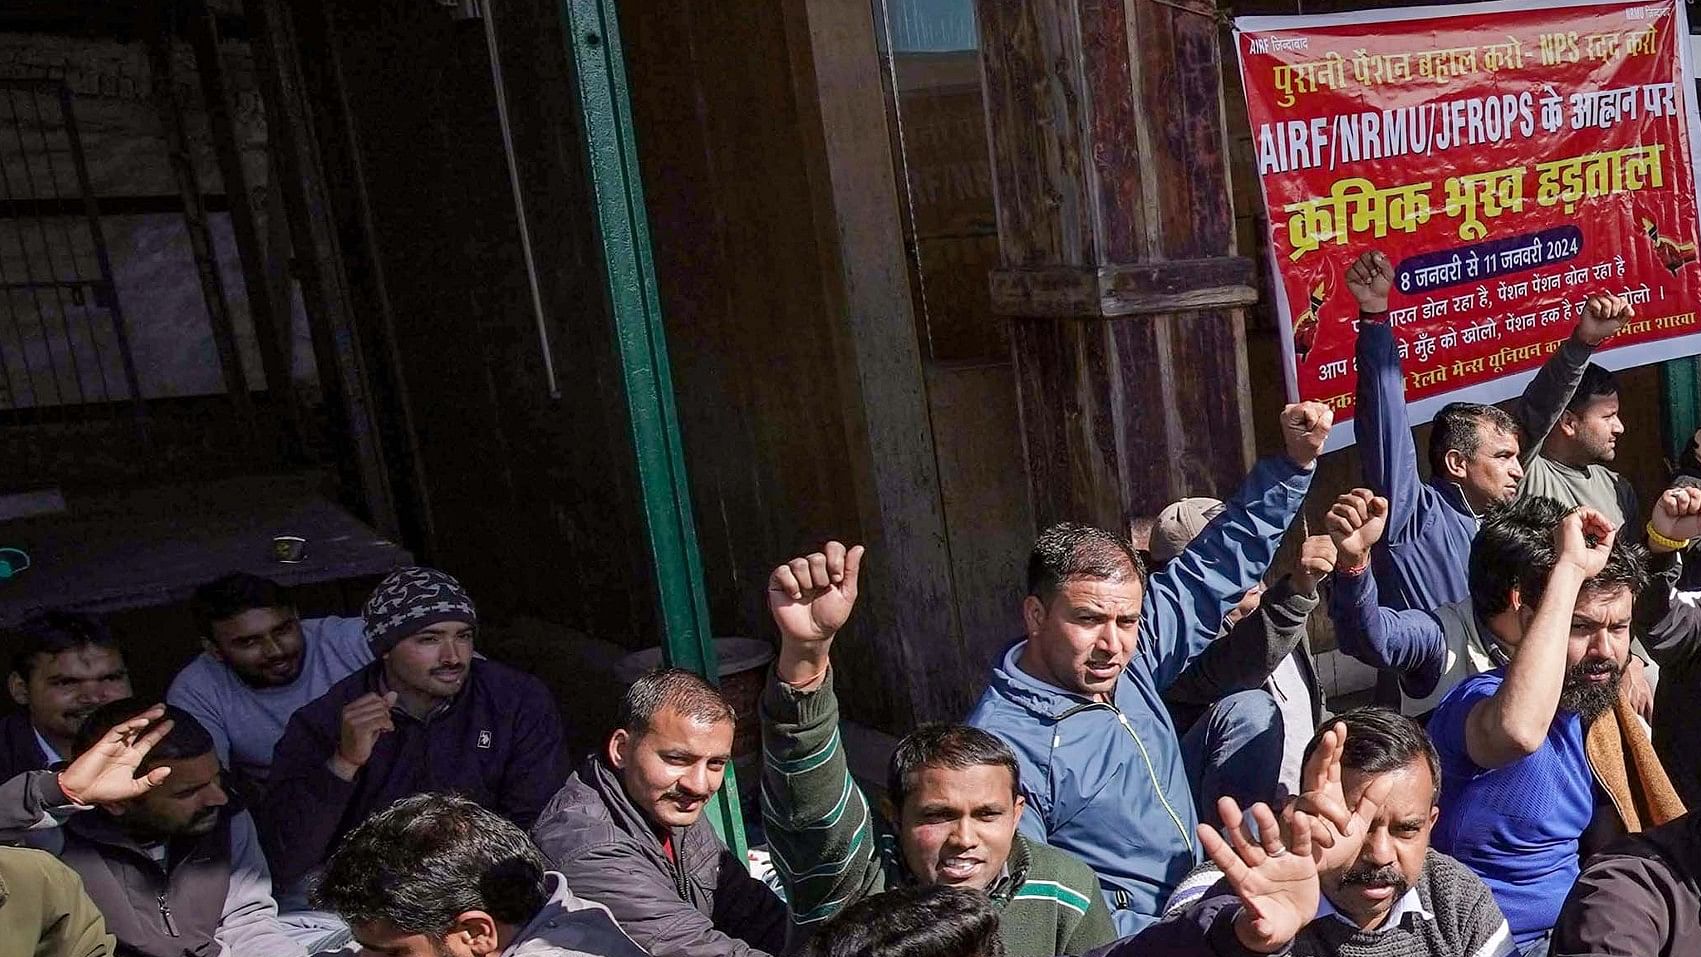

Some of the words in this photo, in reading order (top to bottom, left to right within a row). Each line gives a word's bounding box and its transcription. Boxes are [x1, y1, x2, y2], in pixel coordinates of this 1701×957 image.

[1249, 38, 1269, 54] AIRF
[1273, 51, 1347, 108] पुरानी
[1417, 46, 1479, 84] बहाल
[1539, 31, 1580, 67] NPS
[1624, 23, 1658, 56] करो
[1259, 91, 1535, 176] AIRF/NRMU/JFROPS
[1540, 84, 1563, 133] के
[1643, 82, 1677, 117] पर
[1284, 177, 1433, 262] क्रमिक
[1444, 166, 1527, 241] भूख
[1536, 144, 1665, 217] हड़ताल
[1401, 272, 1411, 292] 8
[1414, 254, 1463, 288] जनवरी
[1465, 250, 1483, 278] से
[1484, 254, 1497, 275] 11
[1500, 236, 1542, 269] जनवरी
[1546, 237, 1579, 261] 2024
[1422, 296, 1449, 319] डोल
[1452, 292, 1475, 313] रहा
[1477, 284, 1493, 309] है,
[1497, 280, 1528, 303] पेंशन
[1531, 272, 1561, 294] पेंशन
[1565, 264, 1589, 286] बोल
[1592, 259, 1612, 280] रहा
[1614, 254, 1626, 279] है
[1318, 360, 1349, 381] आप
[1413, 331, 1437, 362] मुँह
[1440, 326, 1458, 350] को
[1505, 310, 1536, 333] पेंशन
[1540, 307, 1560, 327] हक
[1562, 299, 1573, 321] है
[1410, 366, 1448, 390] रेलवे
[1452, 357, 1485, 378] मेन्स
[1489, 342, 1541, 374] यूनियन
[1656, 312, 1697, 331] शाखा
